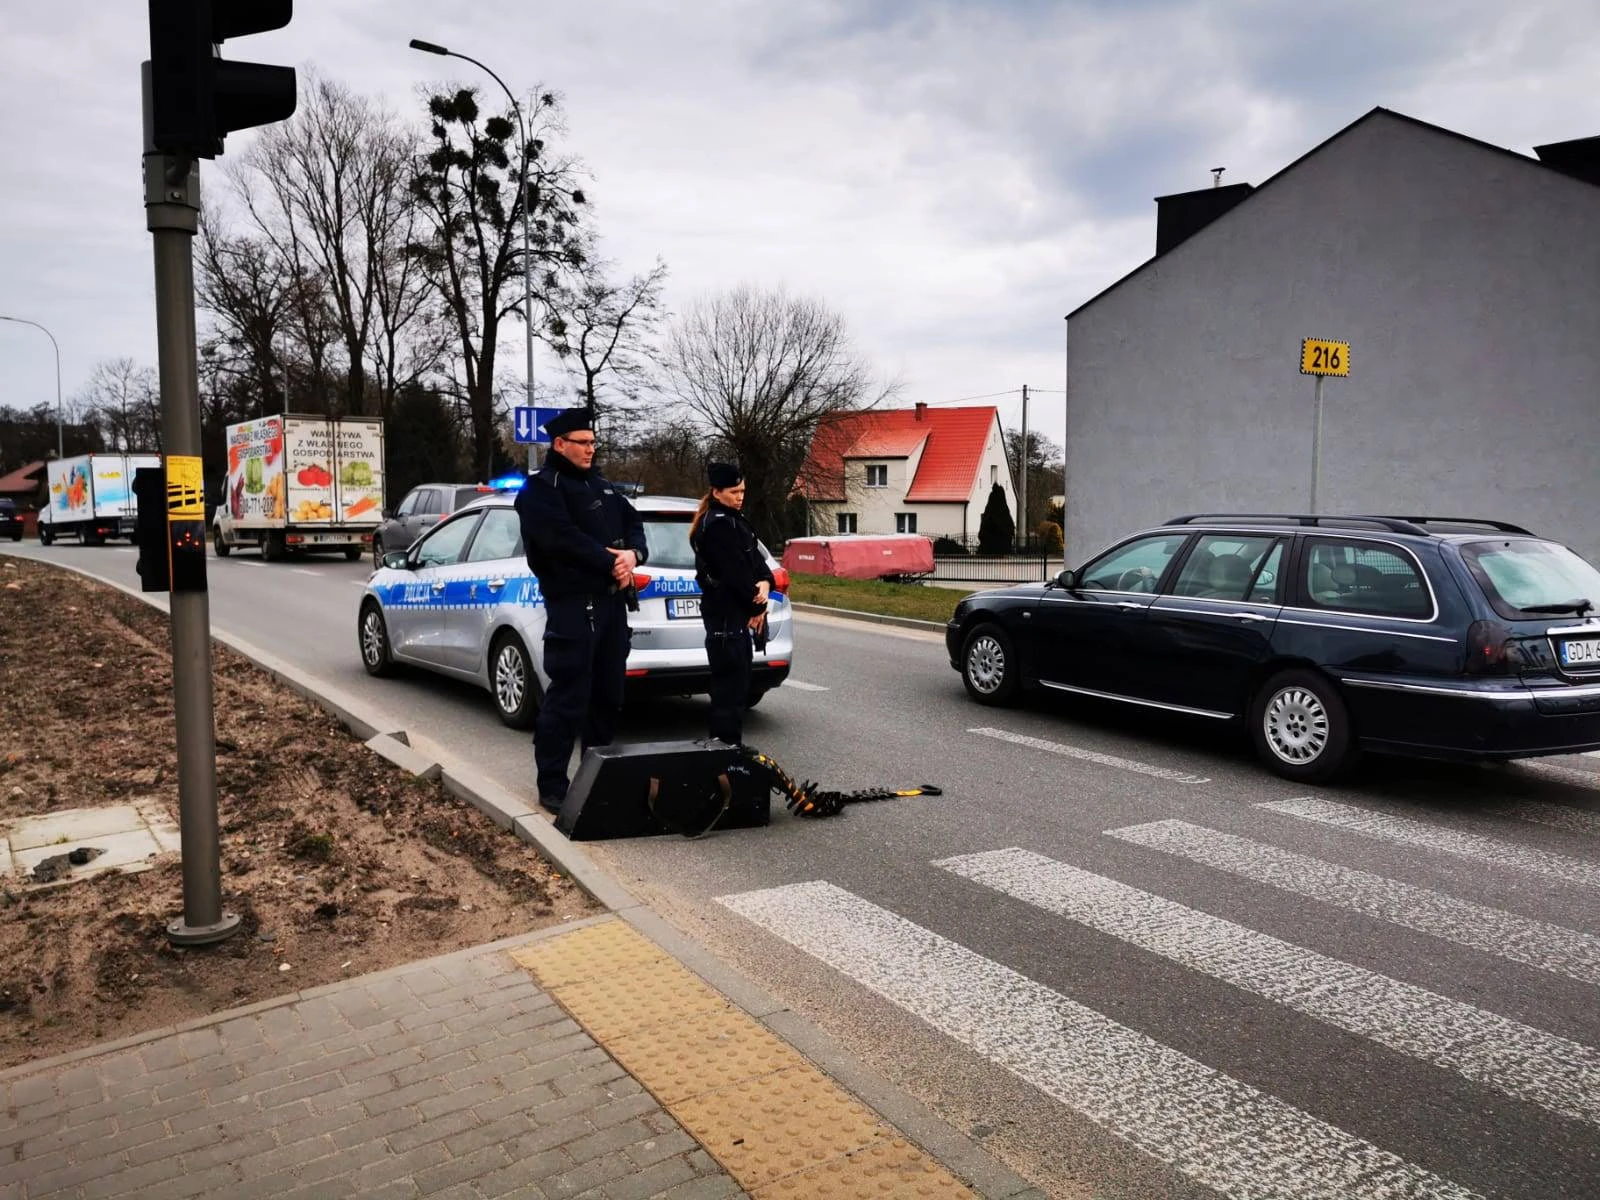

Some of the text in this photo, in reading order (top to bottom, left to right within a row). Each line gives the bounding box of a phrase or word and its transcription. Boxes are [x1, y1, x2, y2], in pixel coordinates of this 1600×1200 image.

[1312, 346, 1340, 369] 216
[404, 584, 430, 602] POLICJA
[654, 581, 695, 592] POLICJA
[1568, 642, 1592, 660] GDA
